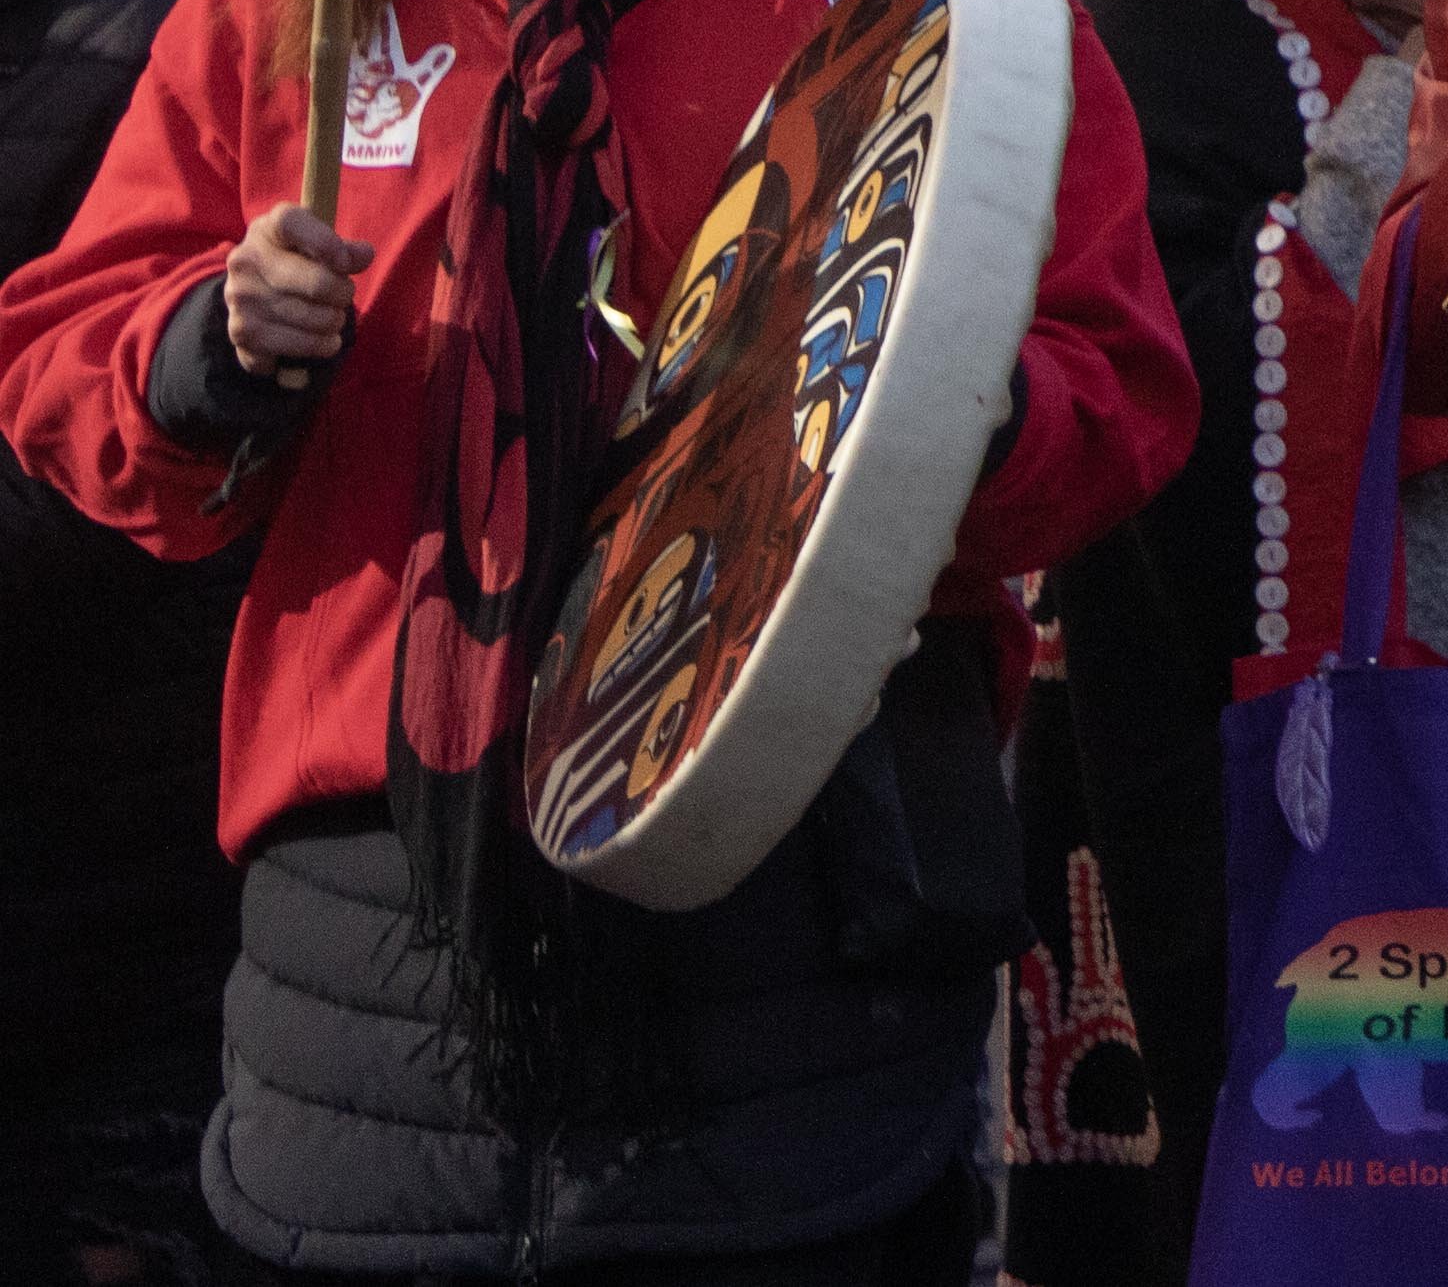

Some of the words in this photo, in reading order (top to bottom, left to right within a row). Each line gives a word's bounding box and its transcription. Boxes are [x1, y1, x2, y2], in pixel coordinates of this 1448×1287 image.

[1328, 943, 1360, 981] 2
[1362, 1003, 1422, 1043] of
[1251, 1161, 1304, 1189] We
[1314, 1159, 1353, 1188] All
